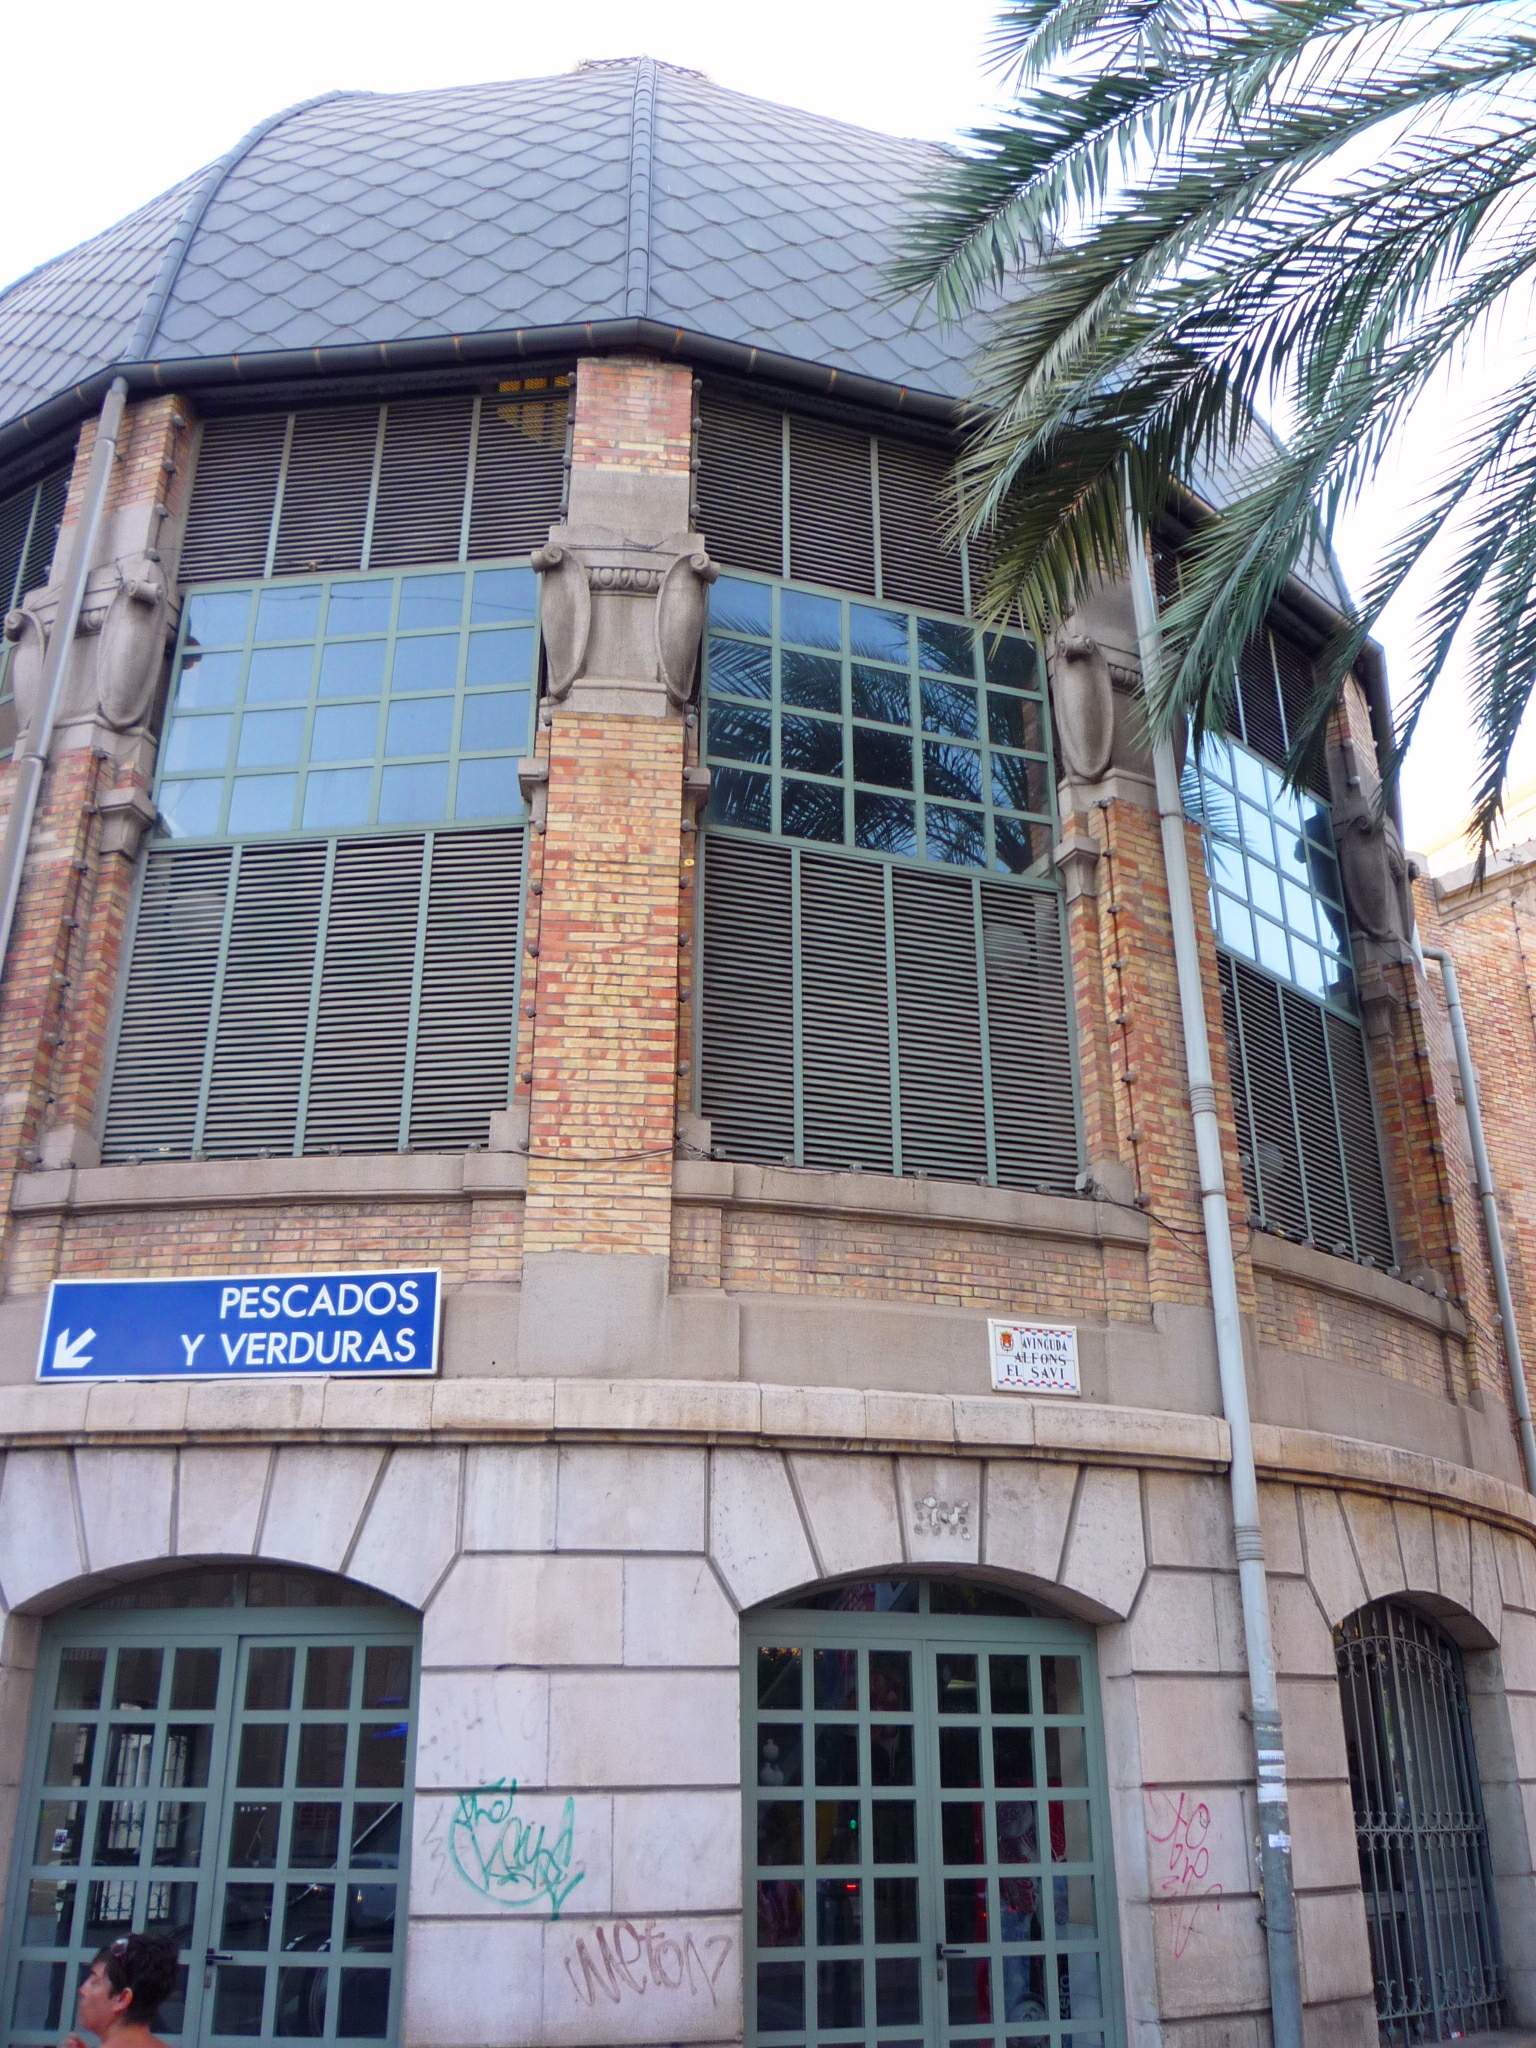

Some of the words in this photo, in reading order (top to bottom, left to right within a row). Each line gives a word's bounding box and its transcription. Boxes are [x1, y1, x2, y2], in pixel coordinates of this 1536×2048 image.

[219, 1280, 419, 1319] PESCADOS
[181, 1334, 205, 1366] Y
[220, 1327, 416, 1366] VERDURAS
[1022, 1337, 1067, 1351] AVINGUDA
[1015, 1352, 1066, 1365] ALFONS
[1007, 1364, 1023, 1377] EL
[1031, 1367, 1064, 1380] SAVI
